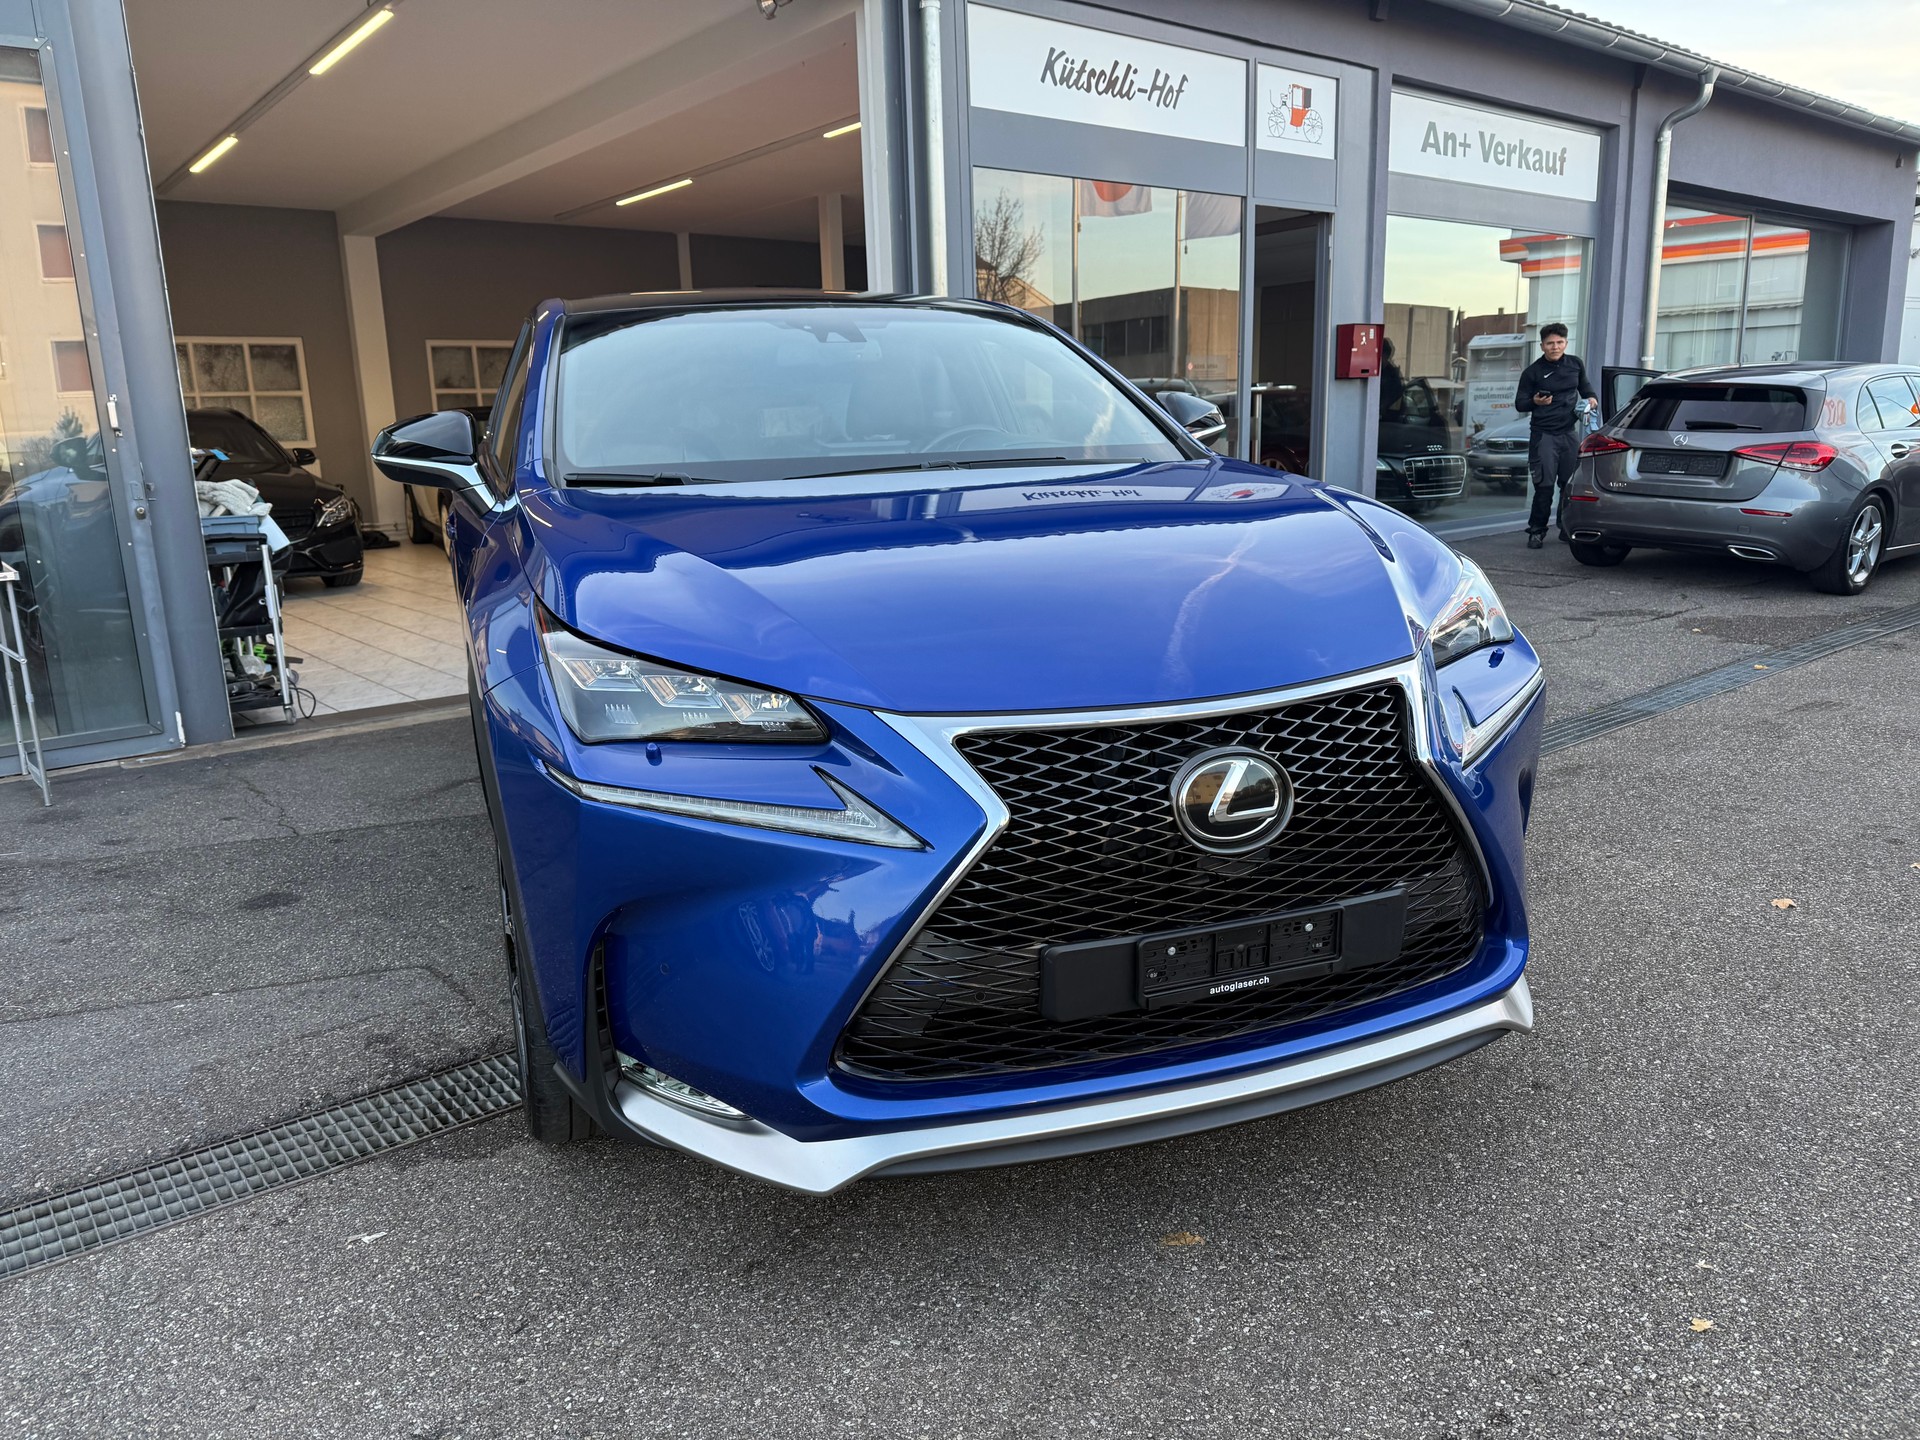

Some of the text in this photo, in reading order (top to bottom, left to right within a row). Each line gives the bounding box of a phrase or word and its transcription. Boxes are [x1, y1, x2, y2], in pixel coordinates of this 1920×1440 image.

[1040, 46, 1189, 110] Kütschli-Hof
[1420, 121, 1568, 176] An+ Verkauf
[1209, 976, 1270, 994] autoglaser.ch
